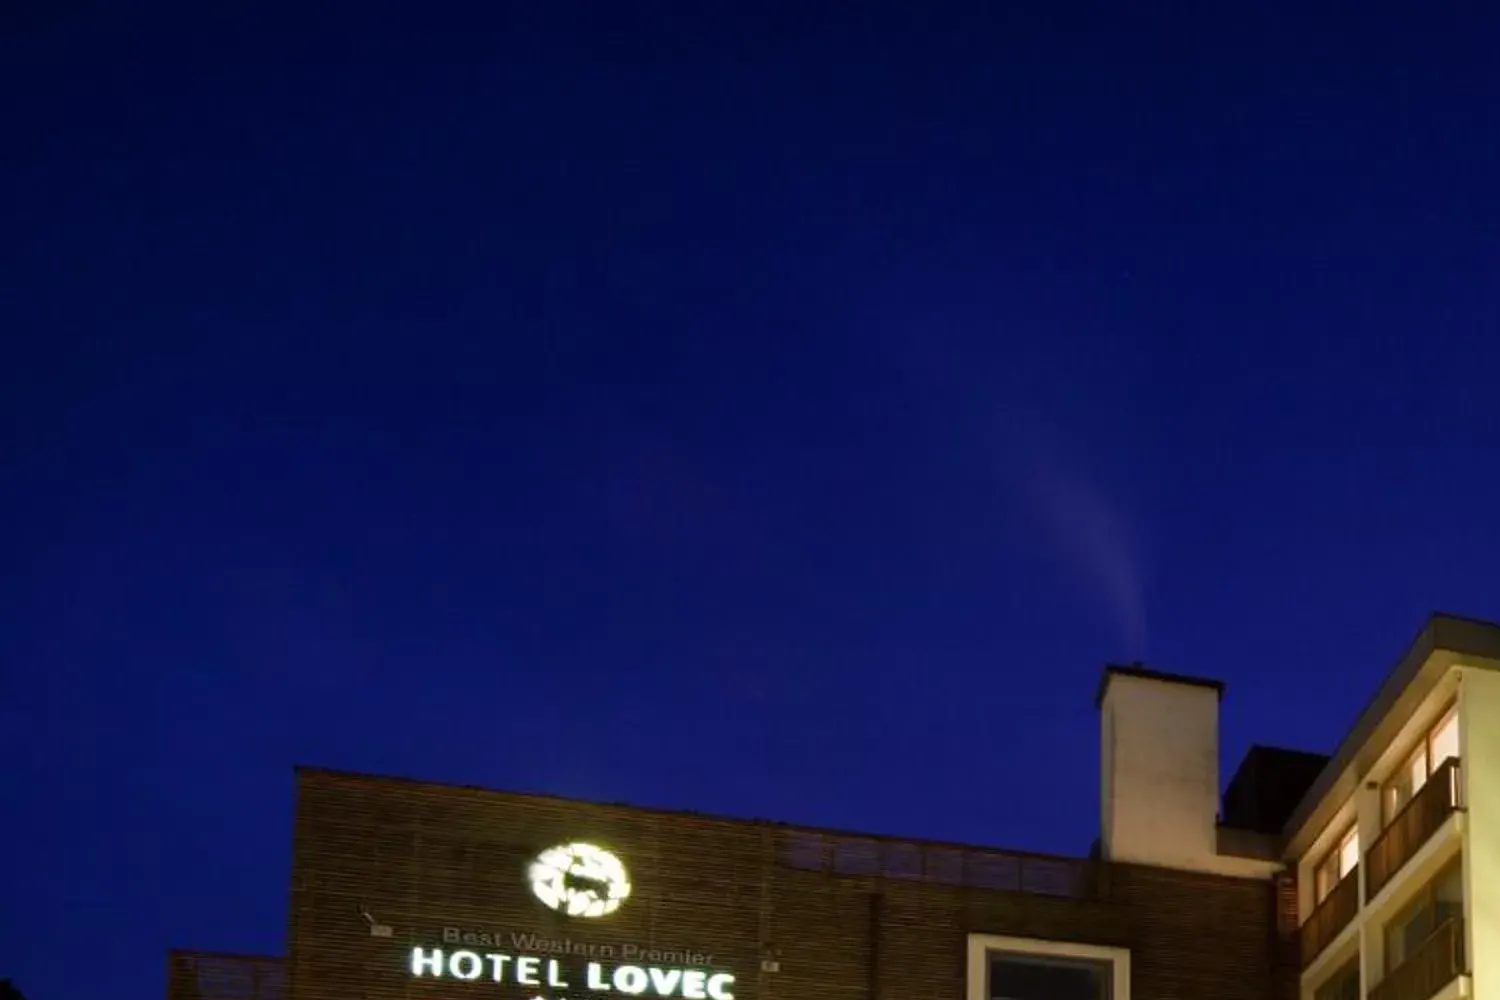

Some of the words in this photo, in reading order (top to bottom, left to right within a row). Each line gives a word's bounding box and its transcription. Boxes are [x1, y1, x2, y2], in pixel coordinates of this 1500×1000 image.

[443, 926, 501, 947] Best
[511, 932, 613, 958] Western
[622, 943, 714, 965] Premier
[411, 946, 569, 988] HOTEL
